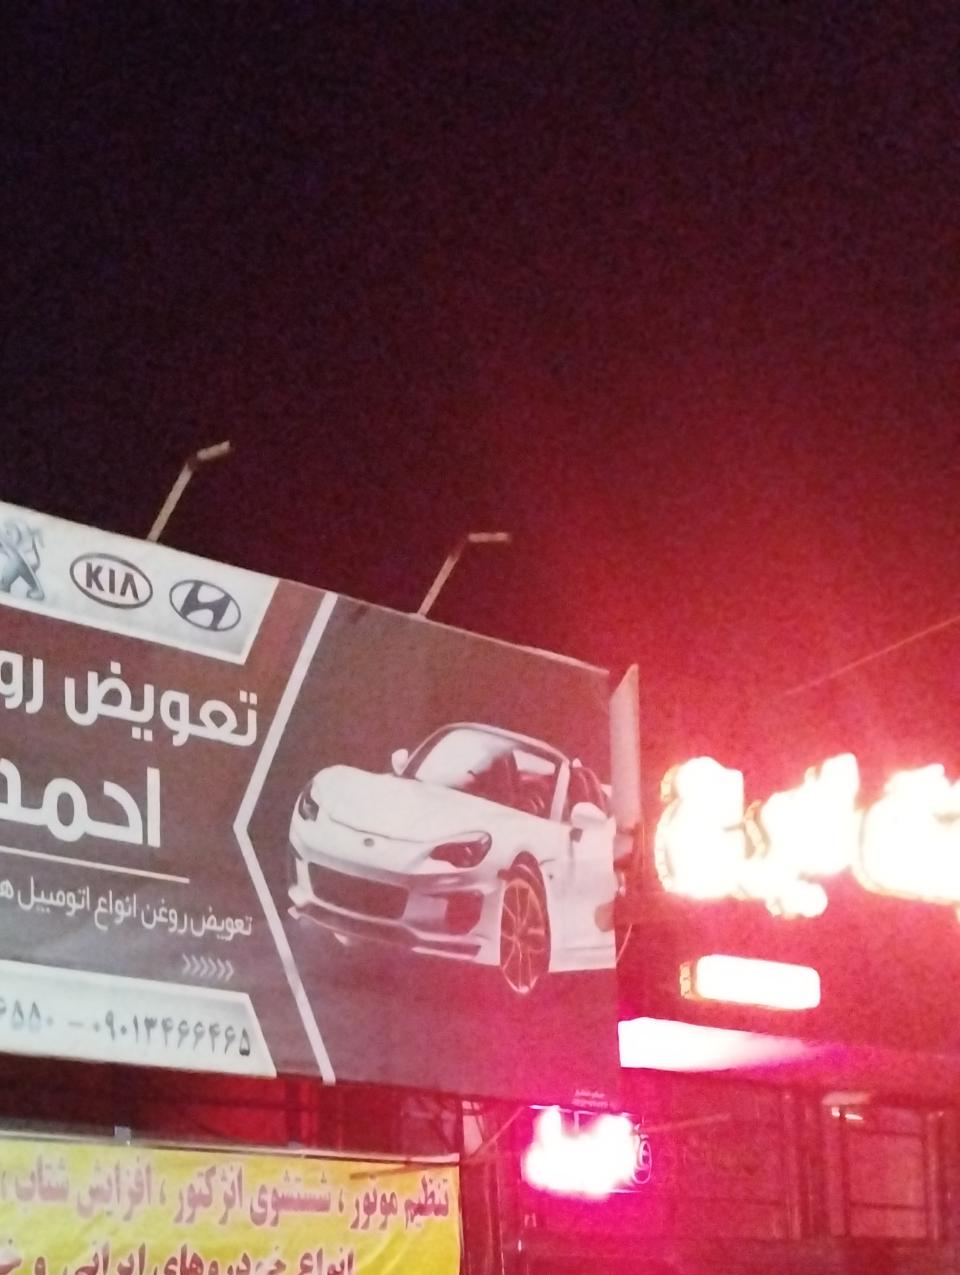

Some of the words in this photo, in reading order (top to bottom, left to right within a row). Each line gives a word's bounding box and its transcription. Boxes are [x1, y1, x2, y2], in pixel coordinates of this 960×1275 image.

[85, 563, 140, 602] KIA
[65, 661, 257, 746] تعویض
[18, 876, 90, 917] اتومبیل
[94, 889, 137, 931] انواع
[141, 899, 187, 933] روغن
[190, 906, 253, 941] تعویض
[404, 1174, 449, 1230] تنظیم
